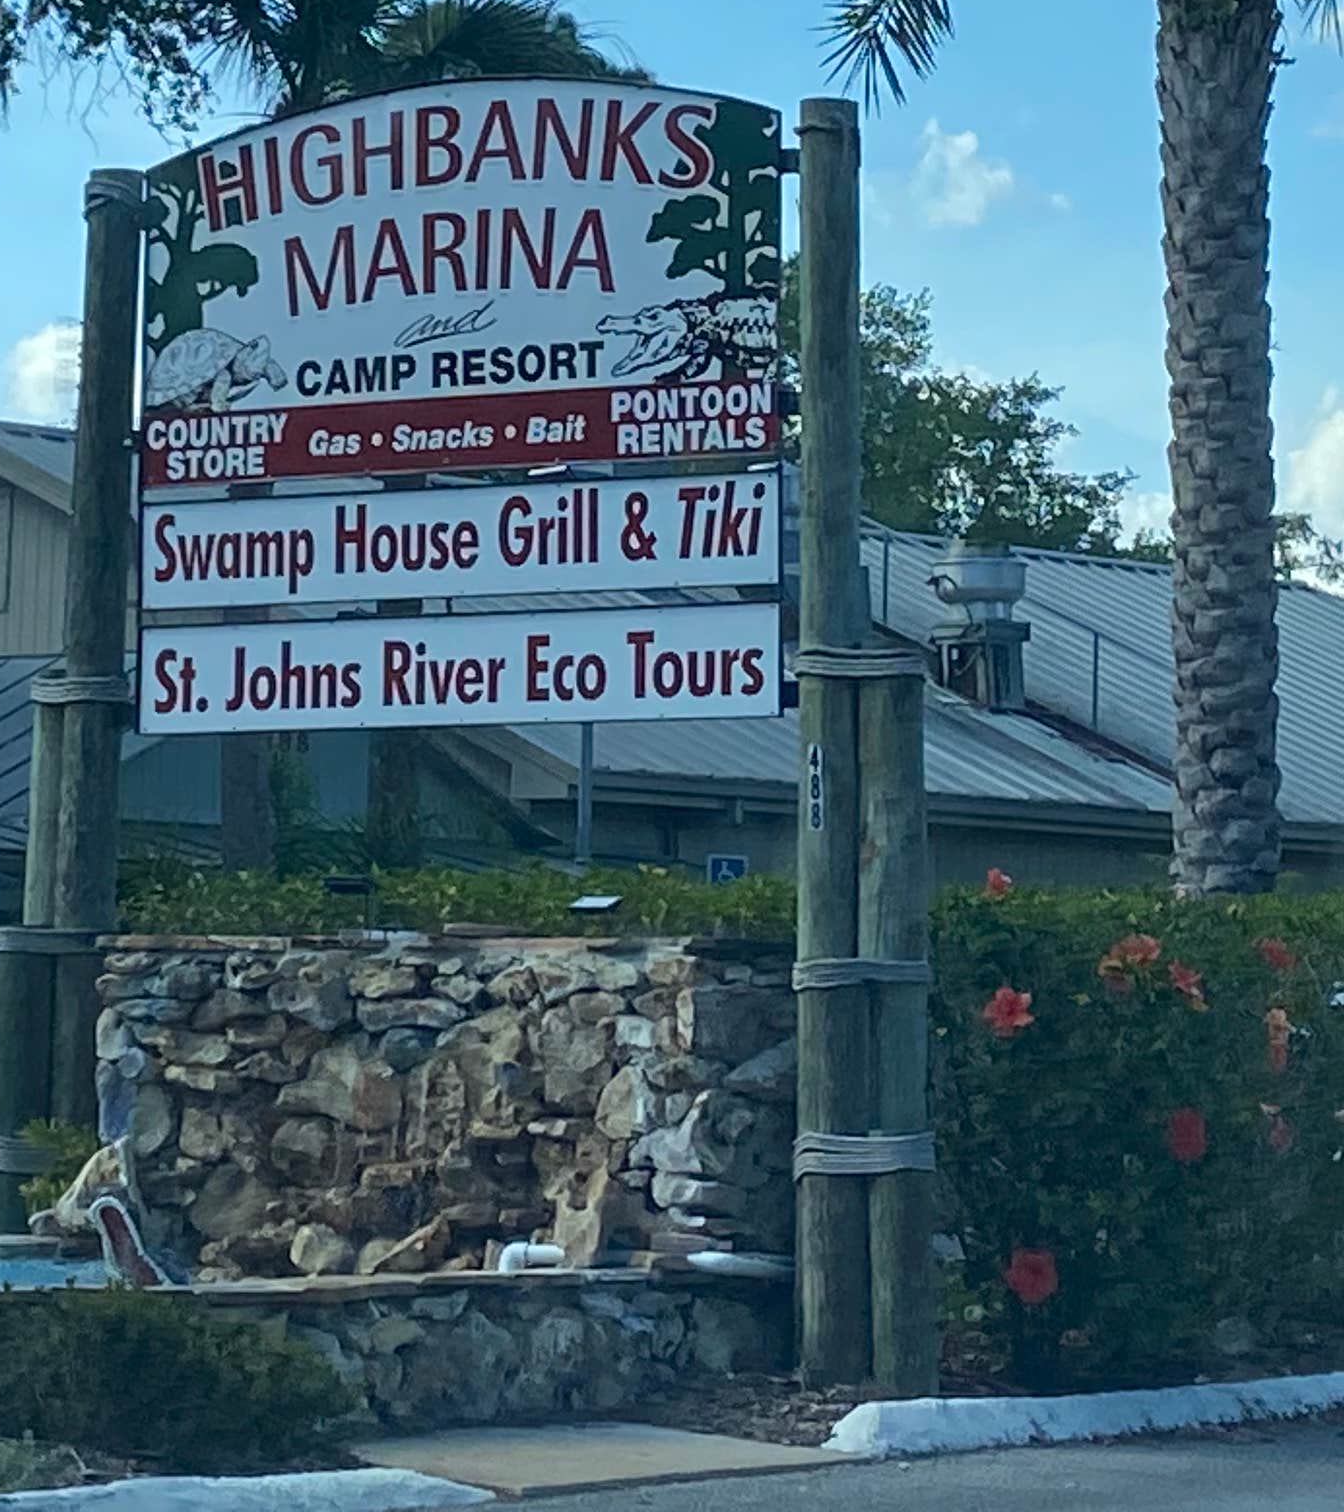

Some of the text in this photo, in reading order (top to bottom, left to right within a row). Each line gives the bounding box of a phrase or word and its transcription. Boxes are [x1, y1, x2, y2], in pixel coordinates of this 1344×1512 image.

[199, 97, 715, 232] HIGHBANKS
[283, 207, 616, 317] MARINA
[393, 300, 497, 347] and
[296, 341, 604, 397] CAMP RESORT
[610, 384, 772, 423] PONTOON
[147, 413, 287, 450] COUNTRY
[308, 416, 586, 456] Gas Snacks Bait
[616, 416, 766, 455] RENTALS
[166, 445, 265, 480] STORE
[154, 480, 766, 594] Swamp House Grill & Tiki
[154, 630, 764, 714] St. Johns River Eco Tours
[809, 745, 823, 830] 488
